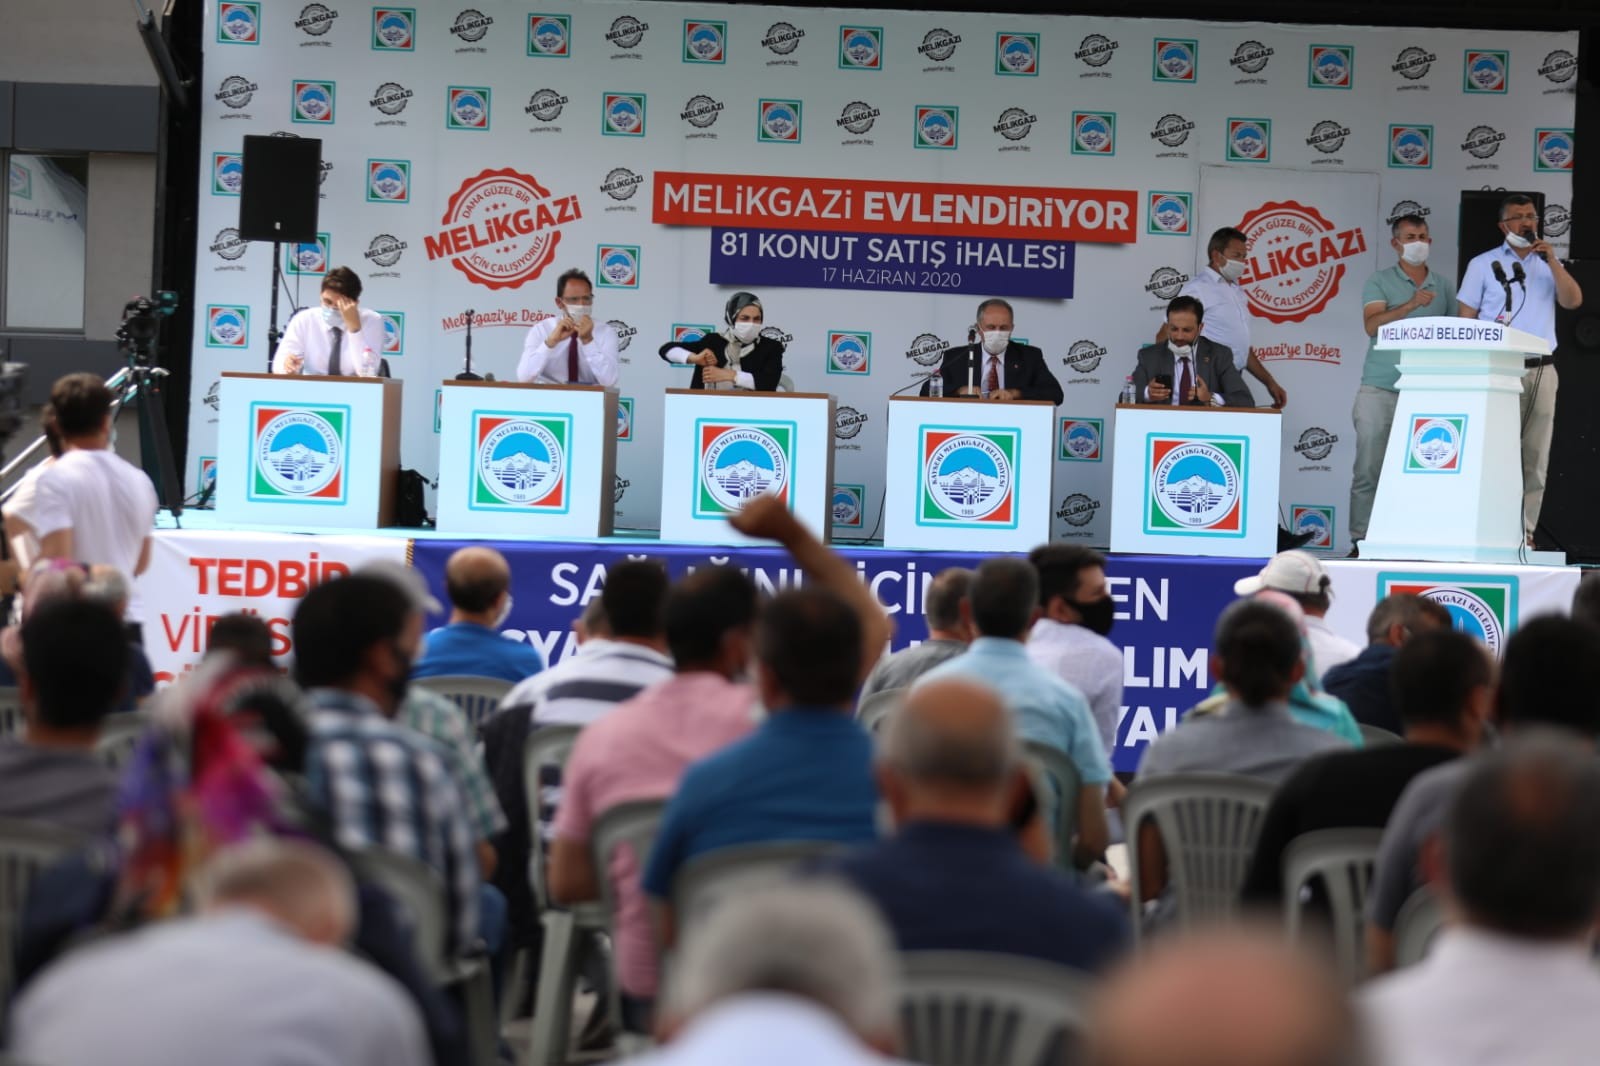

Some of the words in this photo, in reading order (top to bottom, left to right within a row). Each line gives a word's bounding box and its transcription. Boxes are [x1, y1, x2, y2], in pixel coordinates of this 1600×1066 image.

[462, 194, 484, 219] DAHA
[484, 185, 514, 199] GÜZEL
[1266, 217, 1297, 231] GÜZEL
[721, 231, 748, 256] 81
[758, 233, 858, 261] KONUT
[867, 238, 946, 268] SATIŞ
[822, 267, 837, 282] 17
[920, 271, 961, 288] 2020
